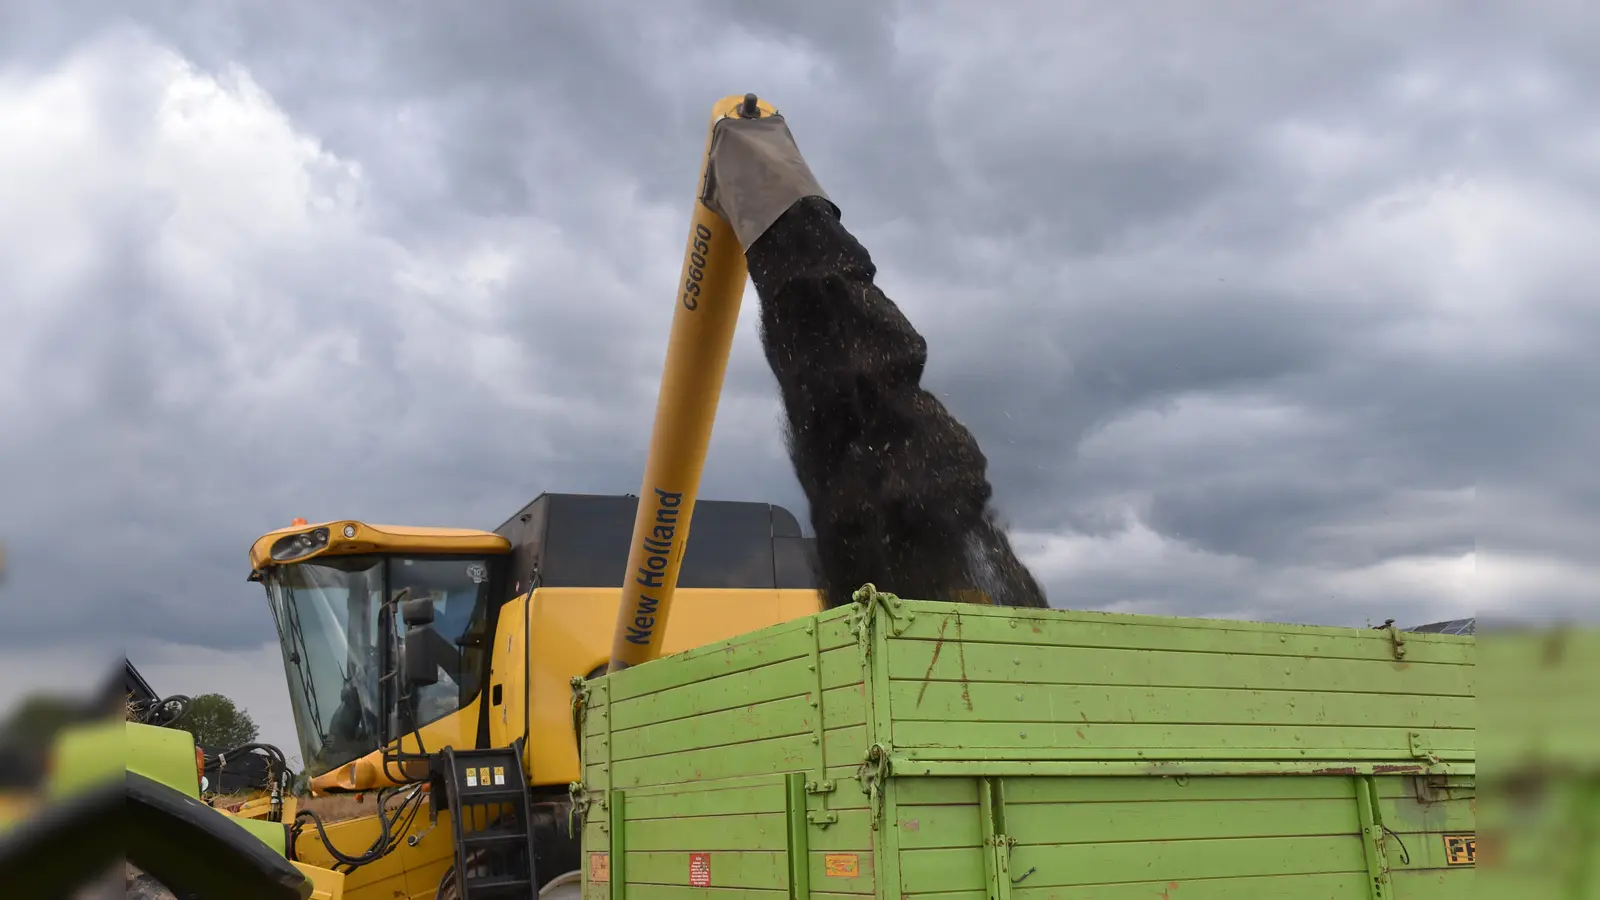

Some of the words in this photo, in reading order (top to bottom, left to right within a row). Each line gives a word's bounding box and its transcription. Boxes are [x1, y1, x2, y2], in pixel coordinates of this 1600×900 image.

[683, 223, 712, 311] CS6050
[636, 486, 683, 588] Holland
[624, 594, 659, 645] New
